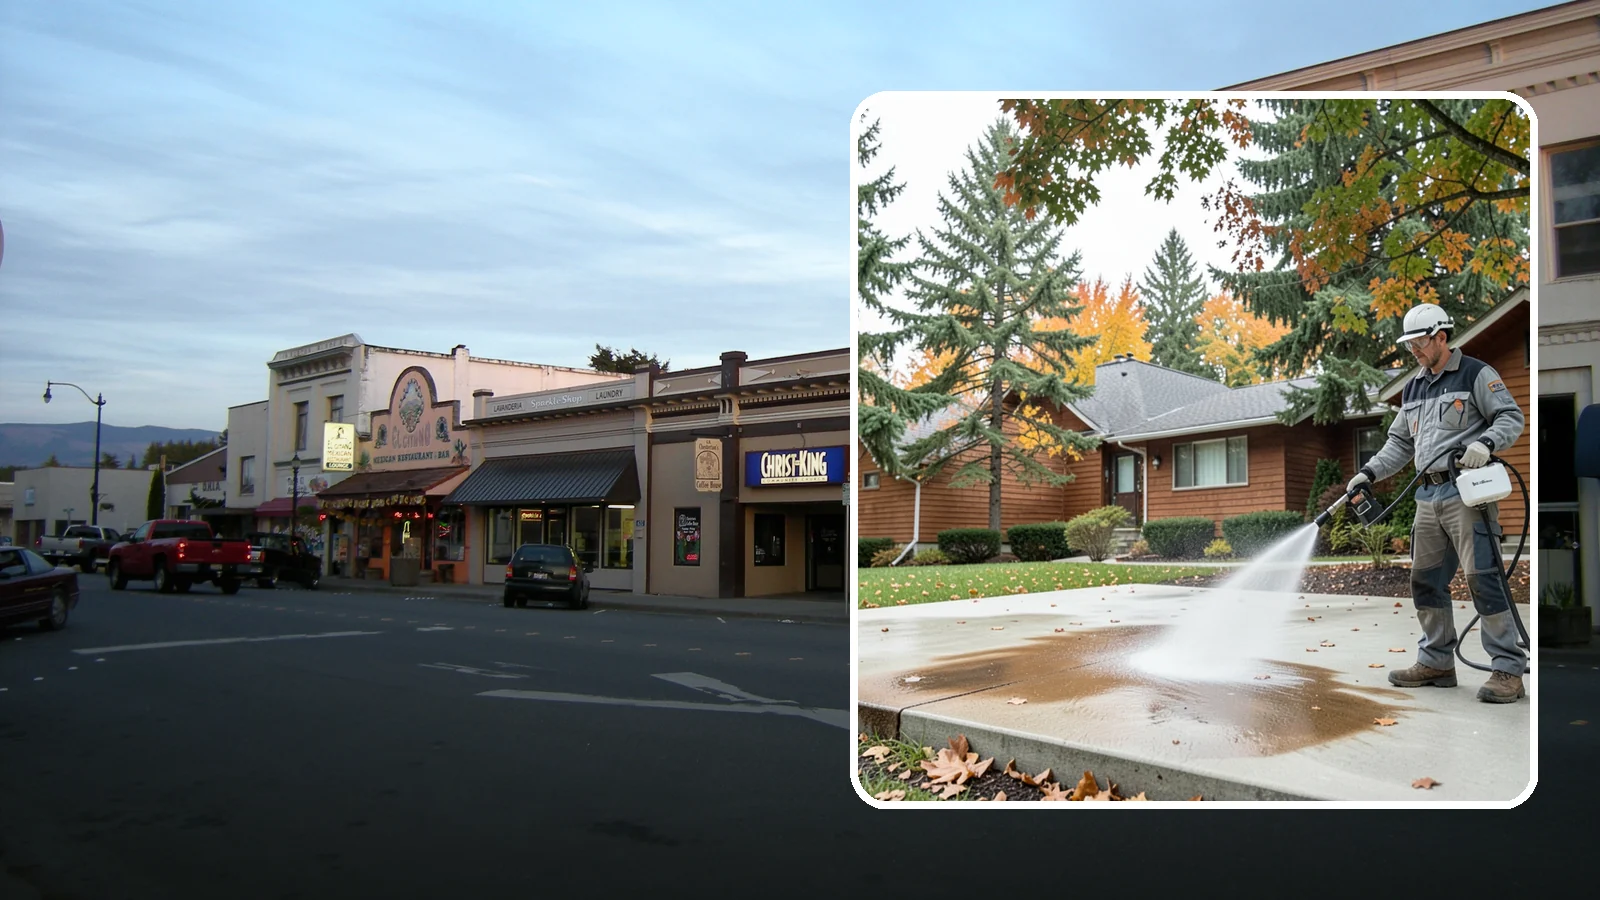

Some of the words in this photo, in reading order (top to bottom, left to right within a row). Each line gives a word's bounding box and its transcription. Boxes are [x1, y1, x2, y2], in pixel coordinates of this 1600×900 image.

[493, 402, 523, 413] LAVANDERIA
[530, 397, 561, 409] Sparkle
[562, 394, 583, 404] Shop
[595, 389, 624, 400] LAUNDRY
[372, 455, 397, 464] MEXICAN
[397, 452, 434, 462] RESTAURANT
[438, 450, 451, 459] BAR
[761, 452, 798, 477] CHRIST
[799, 450, 827, 476] KING
